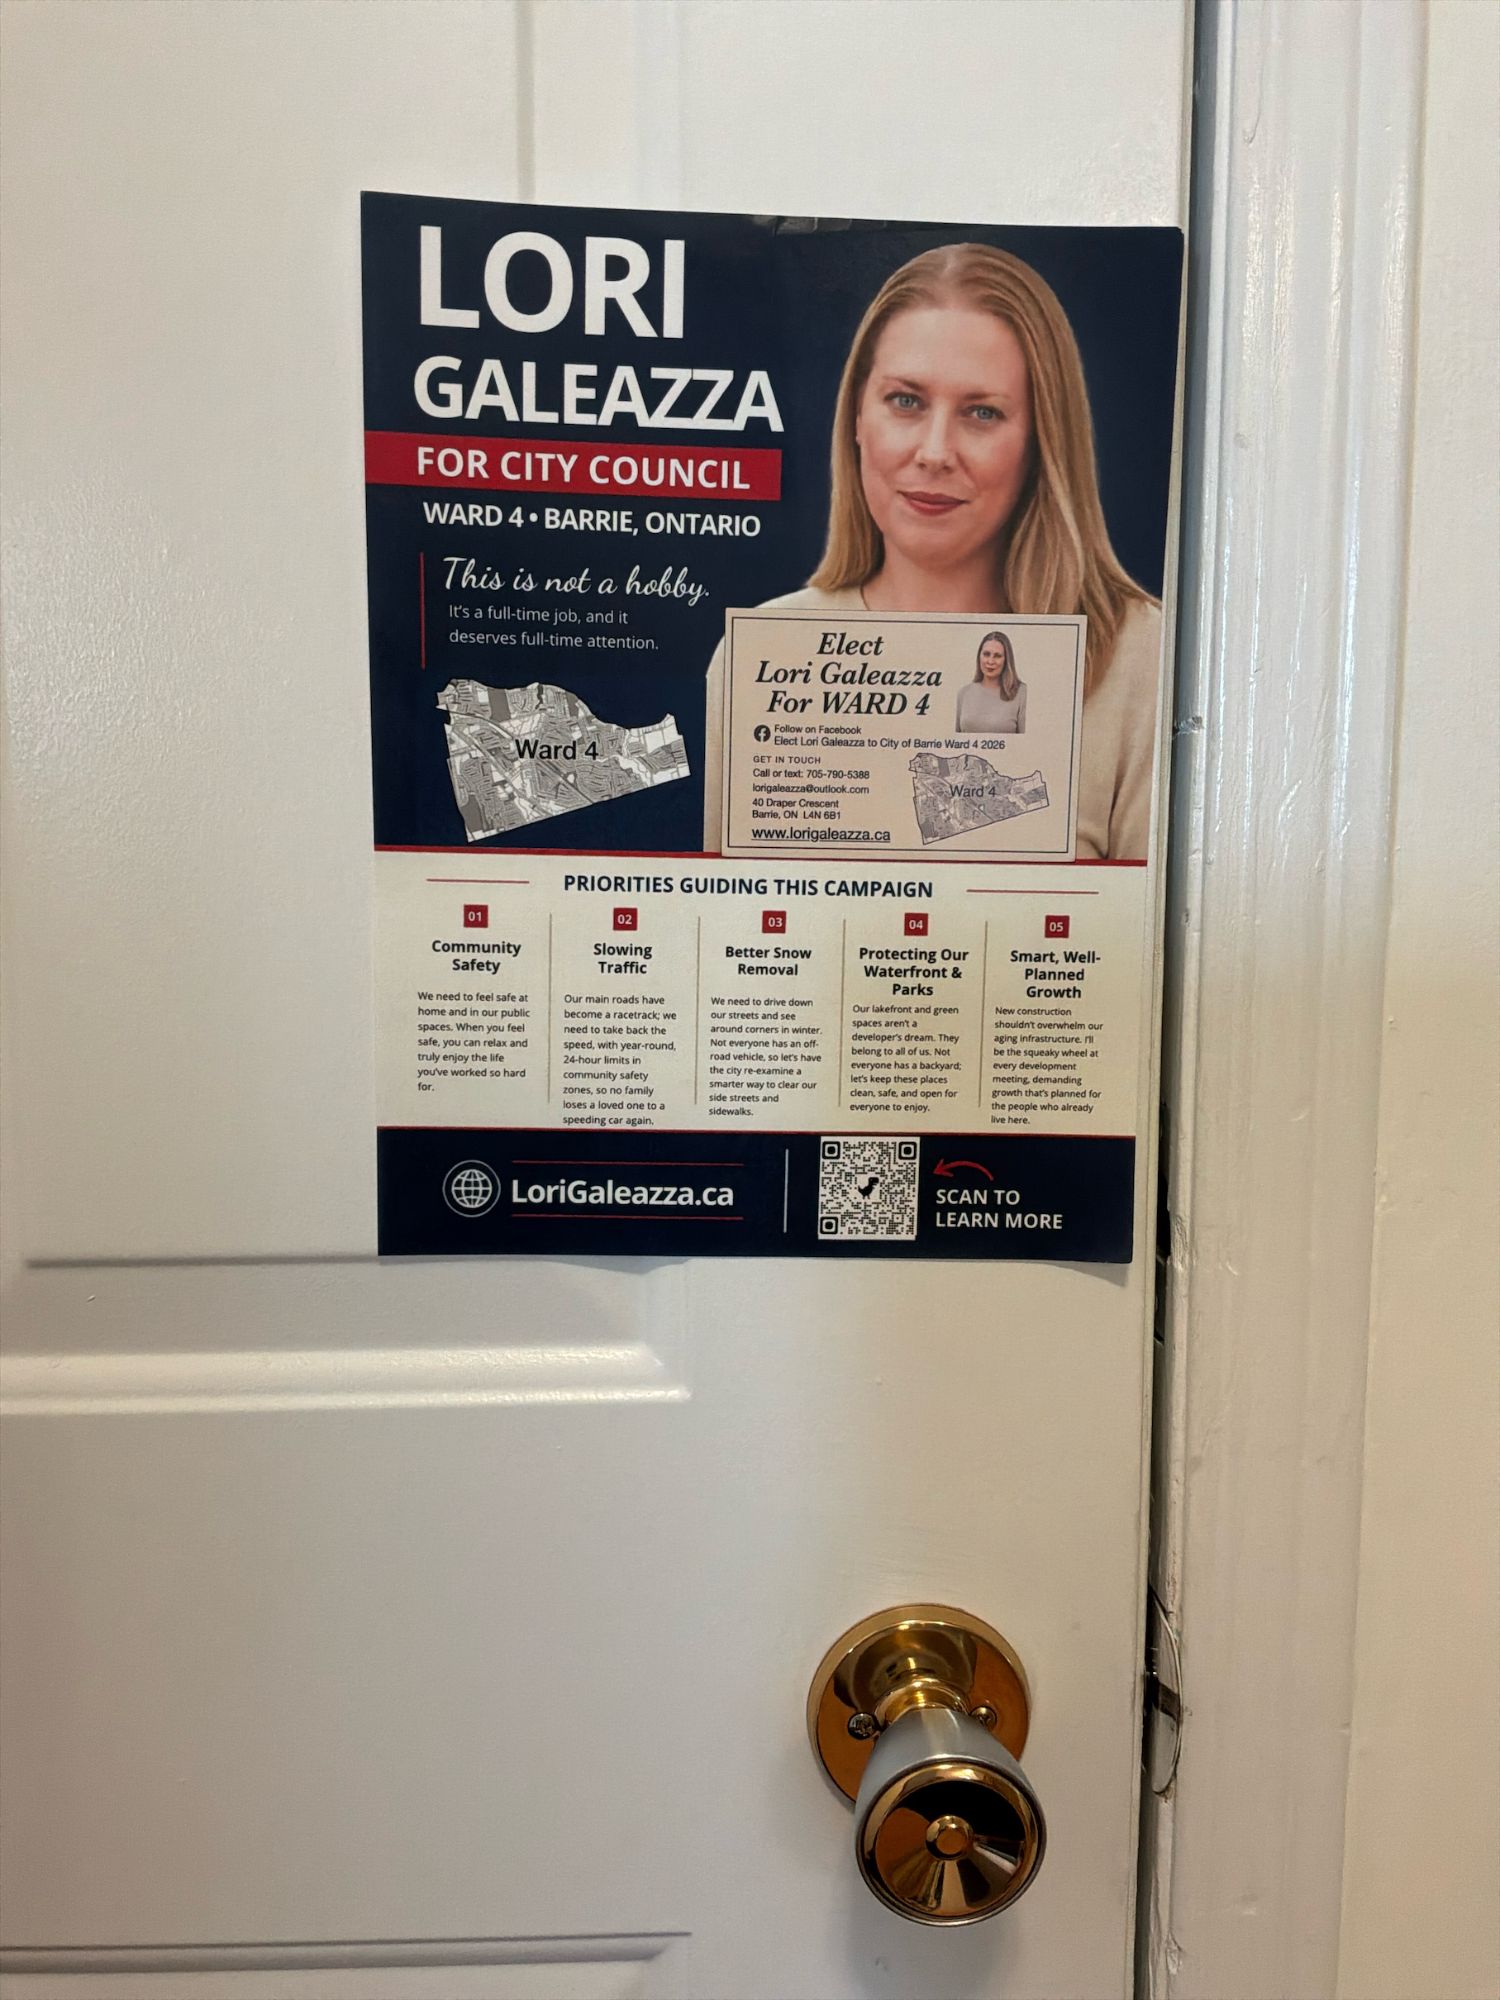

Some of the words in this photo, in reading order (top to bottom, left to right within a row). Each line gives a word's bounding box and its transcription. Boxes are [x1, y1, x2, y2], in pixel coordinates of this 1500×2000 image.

[420, 225, 685, 338] LORI
[413, 355, 784, 432] GALEAZZA
[417, 446, 489, 478] FOR
[500, 451, 578, 482] CITY
[589, 455, 750, 489] COUNCIL
[422, 501, 502, 526] WARD
[508, 506, 524, 527] 4
[544, 507, 638, 536] BARRIE,
[645, 511, 760, 537] ONTARIO
[443, 556, 505, 590] This
[513, 567, 537, 591] is
[544, 567, 591, 593] not
[597, 578, 617, 594] a
[625, 564, 709, 607] hobby.
[474, 608, 482, 618] a
[487, 605, 549, 621] full-time
[552, 608, 580, 625] job,
[585, 610, 613, 623] and
[618, 610, 628, 624] it
[449, 628, 516, 645] deserves
[521, 631, 582, 647] full-time
[587, 635, 658, 649] attention.
[816, 632, 884, 656] Elect
[755, 660, 812, 684] Lori
[820, 661, 942, 686] Galeazza
[766, 690, 813, 713] For
[822, 691, 907, 714] WARD
[914, 693, 930, 715] 4
[774, 723, 803, 733] Follow
[818, 725, 861, 734] Facebook
[773, 735, 798, 746] Elect
[800, 736, 818, 746] Lori
[820, 736, 865, 747] Galeazza
[867, 738, 878, 747] to
[879, 737, 899, 749] City
[901, 738, 911, 748] of
[913, 738, 942, 748] Barrie
[944, 739, 970, 749] Ward
[971, 739, 978, 748] 4
[980, 739, 1005, 749] 2026
[515, 739, 576, 760] Ward
[584, 741, 599, 760] 4
[752, 755, 772, 763] GET
[775, 755, 784, 763] IN
[787, 756, 821, 764] TOUCH
[752, 768, 770, 777] Call
[783, 769, 803, 778] text:
[806, 769, 869, 779] 705-790-5388
[752, 783, 869, 794] lorigaleazza@outlook.com
[949, 785, 983, 797] Ward
[988, 786, 995, 796] 4
[752, 797, 764, 806] 40
[766, 797, 796, 809] Draper
[798, 798, 839, 808] Crescent
[783, 810, 798, 819] ON
[803, 810, 821, 819] L4N
[823, 810, 840, 819] 6B1
[751, 826, 890, 842] www.lorigaleazza.ca
[564, 875, 673, 893] PRIORITIES
[679, 877, 767, 895] GUIDING
[773, 879, 818, 895] THIS
[824, 880, 932, 898] CAMPAIGN
[468, 911, 481, 921] 01
[617, 914, 632, 924] 02
[768, 917, 782, 927] 03
[908, 919, 923, 929] 04
[1049, 921, 1063, 932] 05
[431, 940, 521, 957] Community
[593, 942, 652, 960] Slowing
[725, 946, 770, 958] Better
[773, 946, 812, 959] Snow
[859, 947, 937, 964] Protecting
[940, 948, 969, 961] Our
[1010, 950, 1059, 964] Smart,
[1063, 950, 1100, 963] Well-
[452, 958, 500, 975] Safety
[598, 961, 647, 974] Traffic
[737, 963, 798, 976] Removal
[863, 965, 947, 978] Waterfront
[951, 966, 962, 978] &
[1024, 967, 1084, 981] Planned
[892, 983, 933, 996] Parks
[1026, 985, 1081, 998] Growth
[417, 991, 434, 1000] We
[435, 992, 460, 1001] need
[463, 993, 473, 1001] to
[475, 992, 493, 1002] feel
[496, 992, 516, 1002] safe
[518, 994, 528, 1002] at
[564, 994, 583, 1003] Our
[585, 995, 609, 1003] main
[612, 994, 639, 1004] roads
[641, 995, 665, 1004] have
[710, 997, 725, 1005] We
[727, 997, 750, 1006] need
[752, 998, 762, 1006] to
[763, 997, 786, 1006] drive
[788, 998, 813, 1006] down
[417, 1006, 446, 1016] home
[448, 1007, 467, 1016] and
[469, 1007, 479, 1016] in
[481, 1009, 498, 1017] our
[500, 1008, 530, 1019] public
[564, 1009, 602, 1019] become
[605, 1011, 611, 1019] a
[662, 1012, 676, 1020] we
[761, 1011, 778, 1020] and
[852, 1004, 870, 1013] Our
[872, 1004, 912, 1013] lakefront
[914, 1005, 931, 1013] and
[933, 1007, 959, 1016] green
[995, 1006, 1015, 1015] New
[1016, 1008, 1072, 1016] construction
[564, 1025, 588, 1034] need
[590, 1026, 600, 1034] to
[602, 1025, 623, 1034] take
[626, 1025, 648, 1035] back
[650, 1025, 666, 1035] the
[710, 1025, 743, 1033] around
[744, 1026, 779, 1034] corners
[852, 1020, 882, 1029] spaces
[1036, 1021, 1085, 1030] overwhelm
[938, 1033, 959, 1044] They
[993, 1034, 1017, 1044] aging
[1032, 1075, 1082, 1086] demanding
[512, 1178, 733, 1206] LoriGaleazza.ca
[936, 1189, 987, 1204] SCAN
[993, 1189, 1020, 1205] TO
[936, 1211, 998, 1227] LEARN
[1005, 1213, 1062, 1229] MORE
